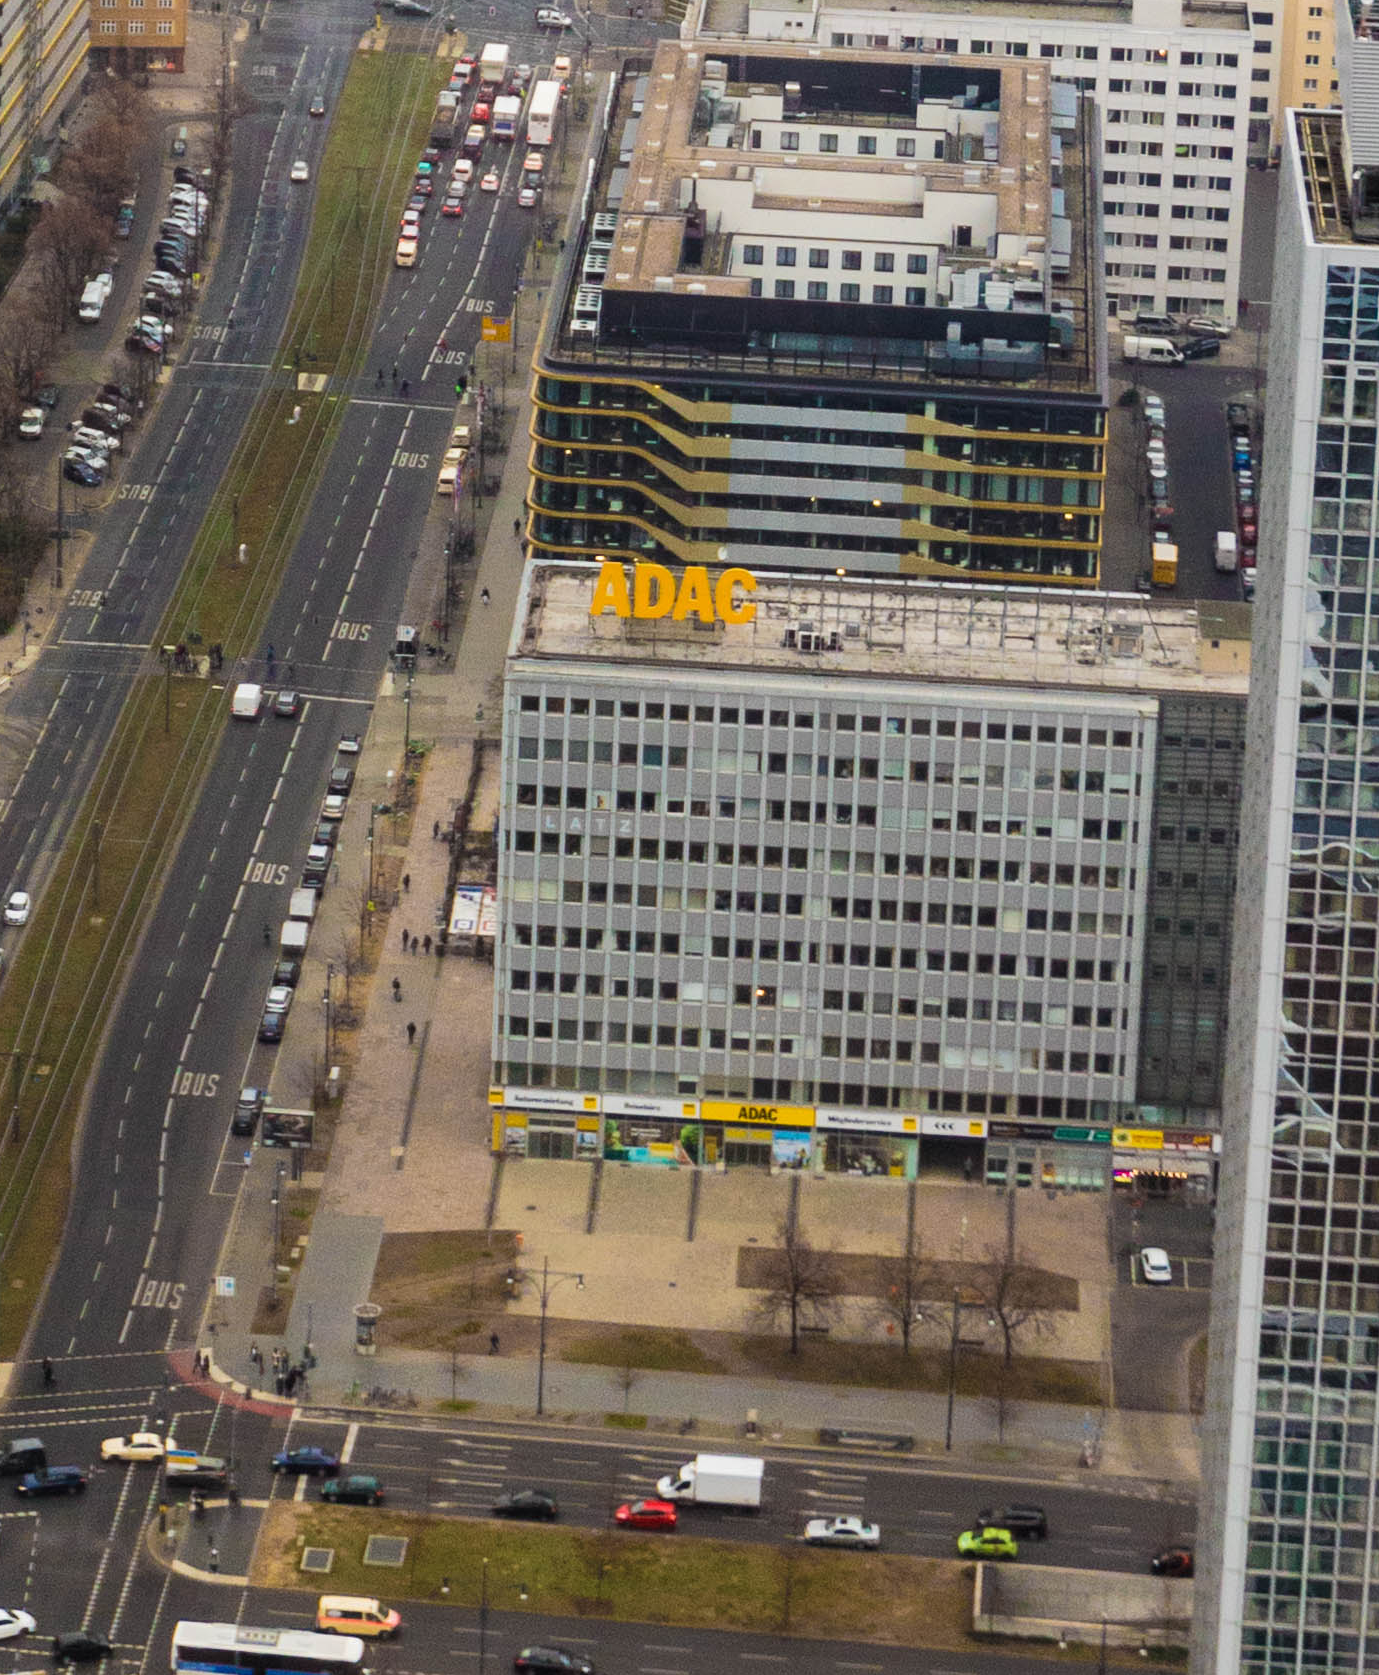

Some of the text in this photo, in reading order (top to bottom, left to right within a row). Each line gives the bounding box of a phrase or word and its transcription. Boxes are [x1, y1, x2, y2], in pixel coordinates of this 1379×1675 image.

[465, 299, 495, 313] BUS
[398, 452, 429, 468] BUS
[590, 561, 759, 625] ADAC
[337, 622, 372, 641] BUS
[177, 1073, 220, 1097] BUS
[738, 1106, 779, 1122] ADAC
[139, 1280, 186, 1310] BUS
